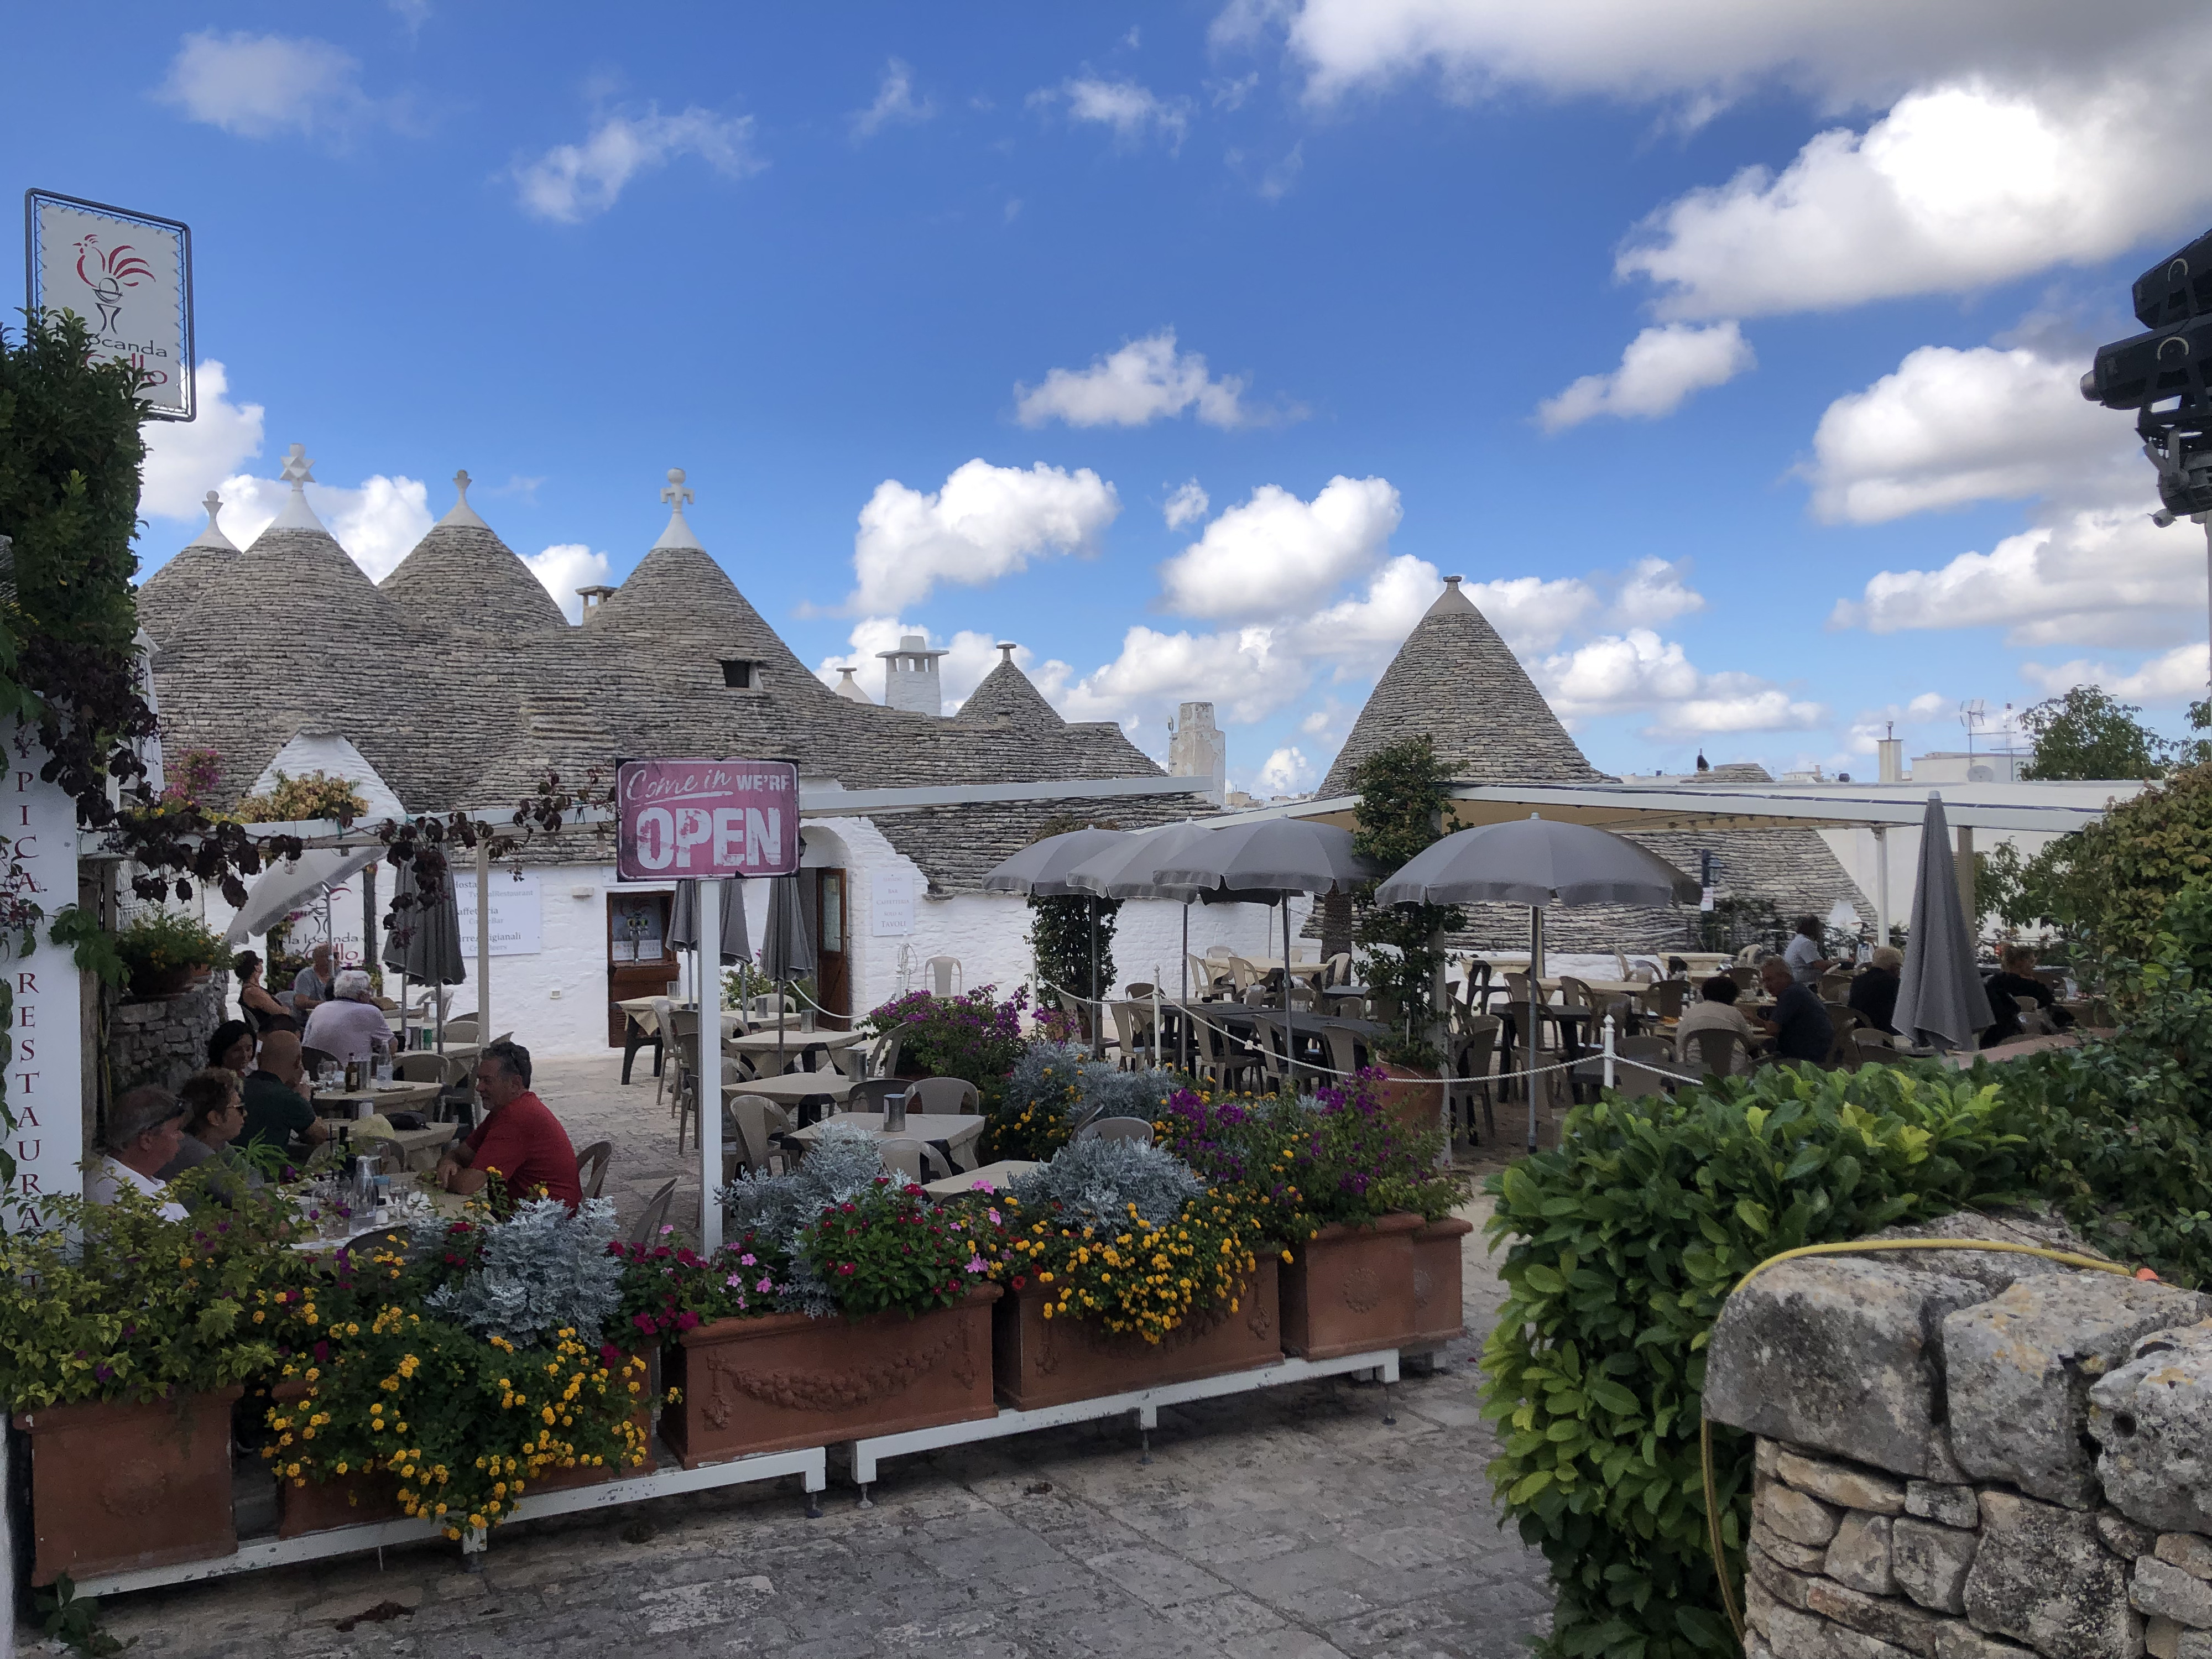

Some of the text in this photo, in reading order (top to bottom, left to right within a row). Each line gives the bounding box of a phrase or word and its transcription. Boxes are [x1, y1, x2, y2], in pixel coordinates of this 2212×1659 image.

[86, 334, 167, 357] ocanda
[626, 769, 698, 800] Come
[703, 769, 732, 789] in
[636, 807, 781, 870] OPEN
[304, 932, 359, 944] locnda
